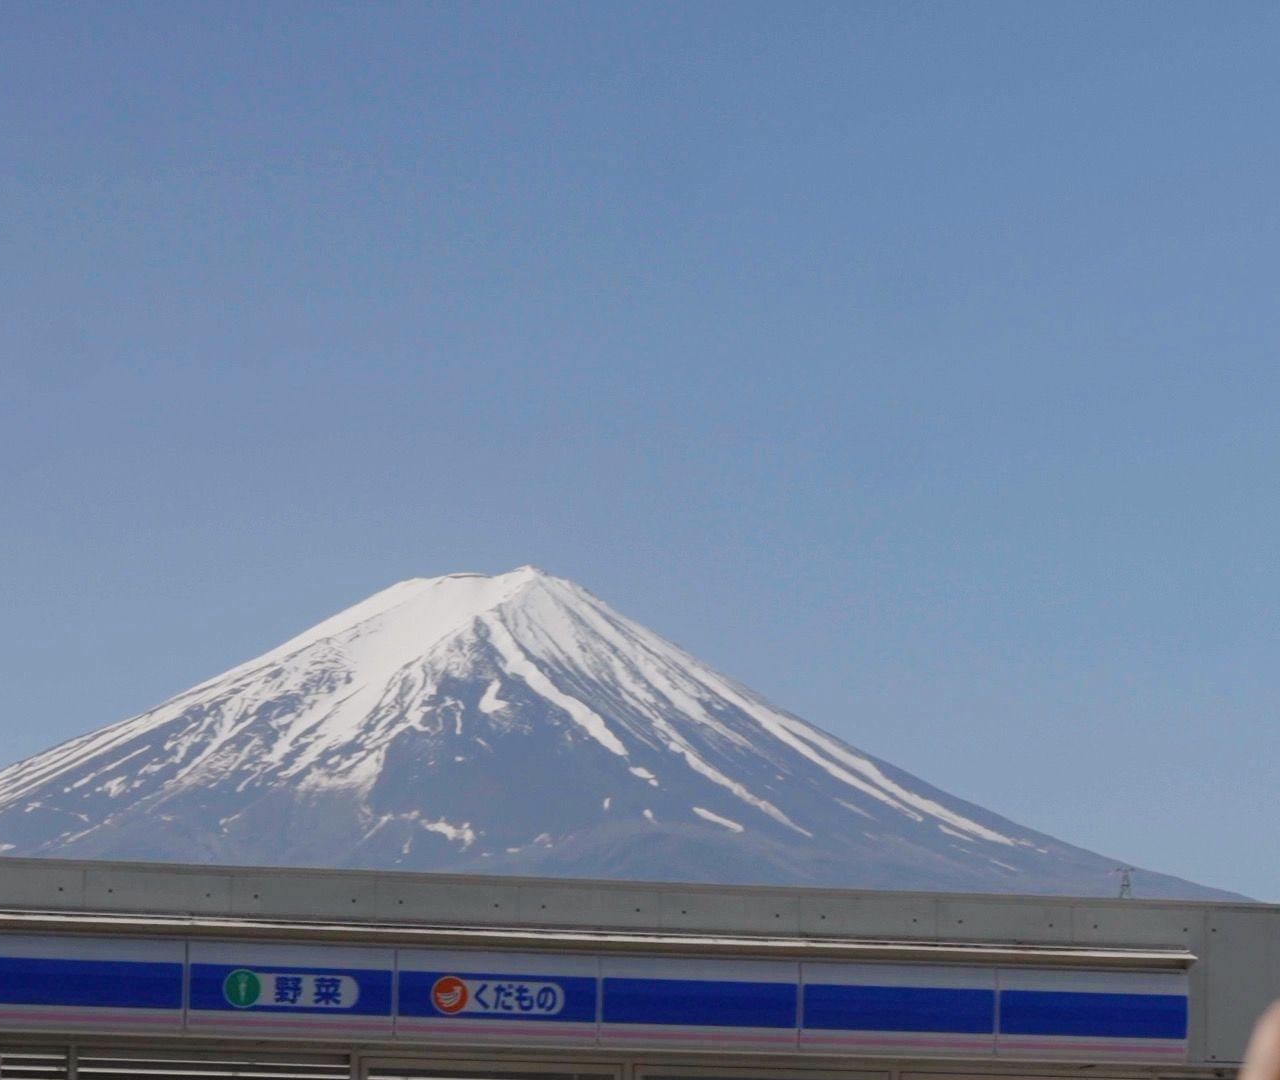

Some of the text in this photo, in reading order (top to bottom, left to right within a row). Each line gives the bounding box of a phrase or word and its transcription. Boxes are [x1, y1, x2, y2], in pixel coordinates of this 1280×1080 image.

[274, 974, 343, 1006] 野菜
[473, 982, 557, 1012] くだもの
